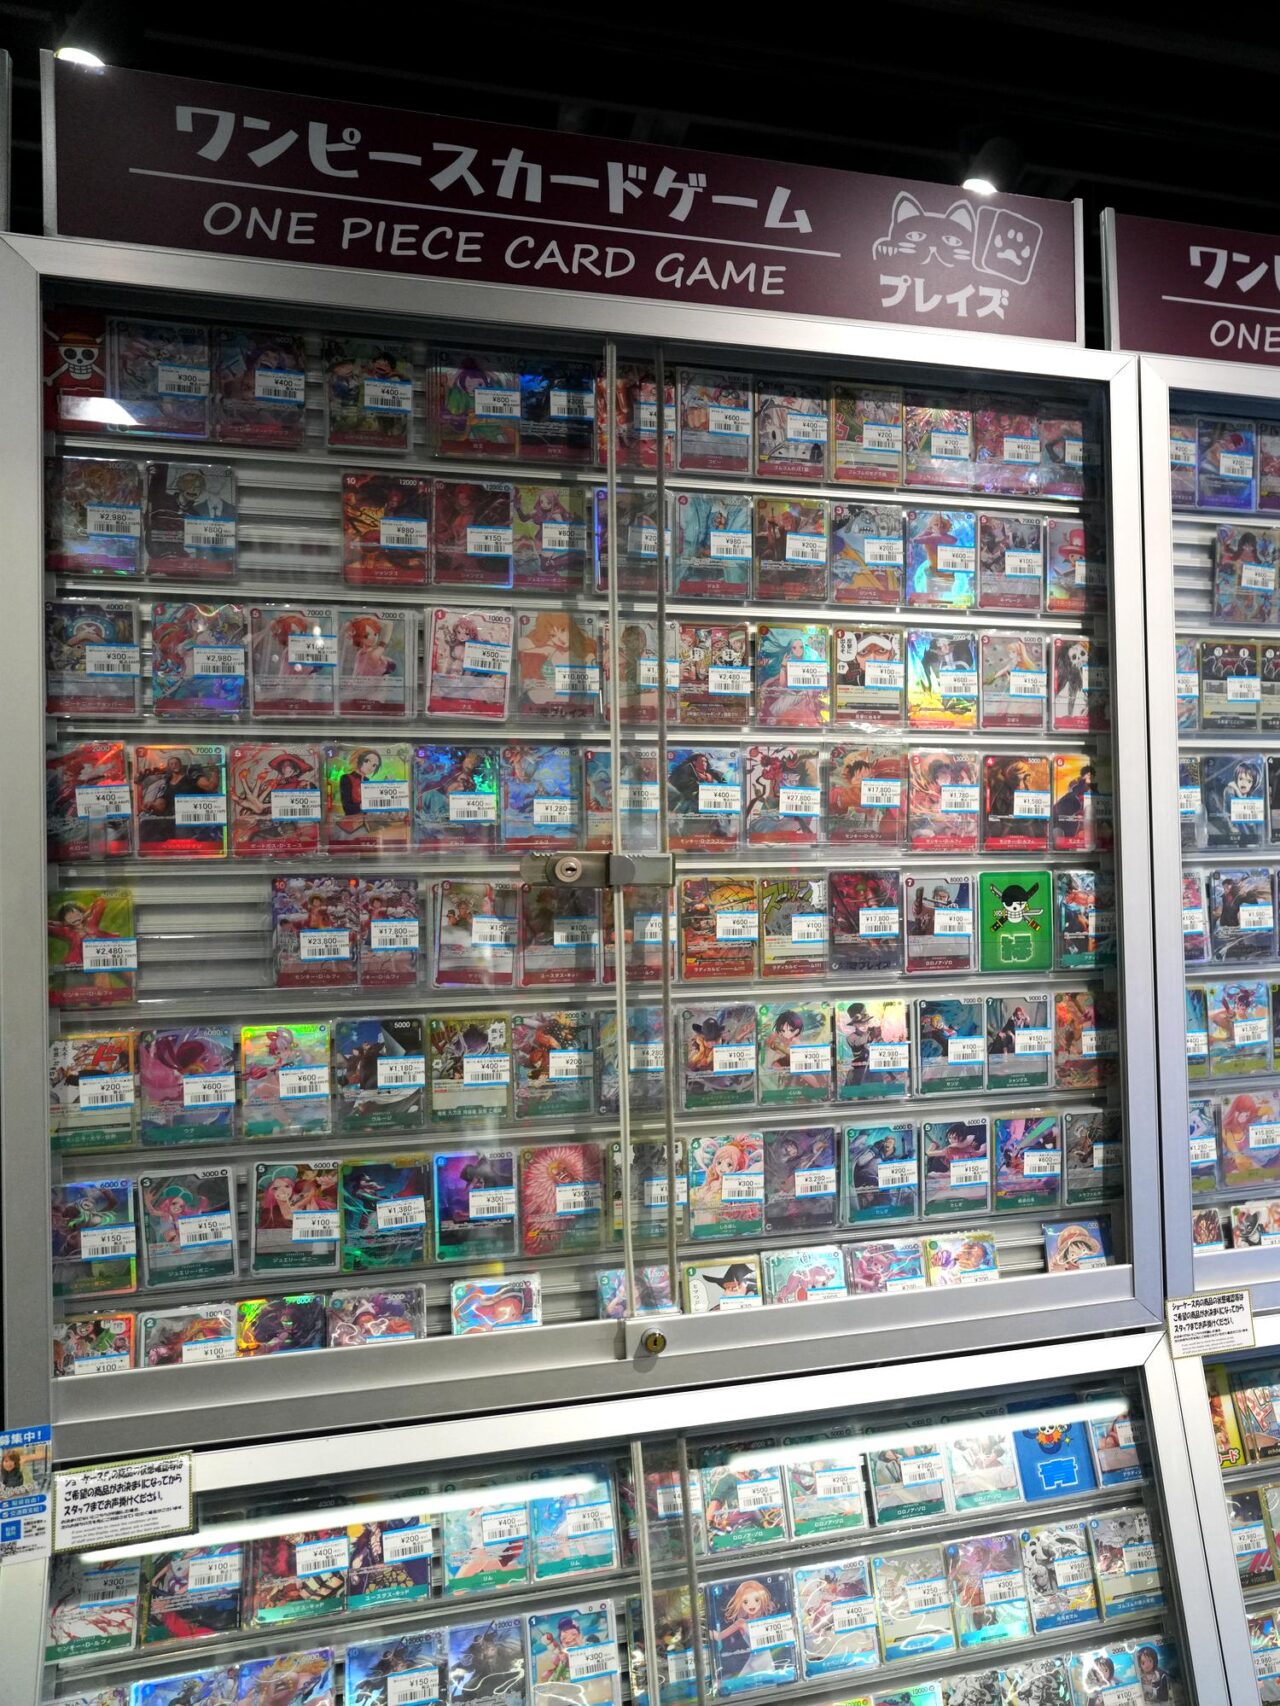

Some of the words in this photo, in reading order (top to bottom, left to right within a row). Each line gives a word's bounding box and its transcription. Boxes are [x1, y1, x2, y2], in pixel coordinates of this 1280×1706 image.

[176, 105, 813, 234] ワンピースカードゲーム
[202, 201, 317, 245] ONE
[341, 217, 484, 264] PIECE
[503, 236, 635, 280] CARD
[655, 253, 786, 296] GAME
[879, 274, 1010, 320] プレイズ
[178, 374, 197, 382] ¥300
[274, 379, 293, 387] ¥400
[381, 388, 399, 396] ¥400
[100, 513, 127, 522] ¥2,980
[397, 526, 414, 534] ¥980
[485, 534, 501, 542] ¥150
[107, 653, 127, 661] ¥300
[206, 654, 232, 662] ¥2,980
[482, 650, 499, 658] ¥500
[96, 793, 116, 801] ¥400
[290, 797, 309, 805] ¥500
[193, 802, 212, 810] ¥100
[379, 927, 408, 935] ¥17,800
[307, 937, 337, 945] ¥23,800
[96, 947, 123, 955] ¥2,480
[389, 1064, 413, 1072] ¥1,180
[297, 1074, 317, 1082] ¥600
[100, 1083, 121, 1091] ¥200
[202, 1082, 222, 1090] ¥600
[486, 1195, 504, 1203] ¥300
[388, 1205, 413, 1213] ¥1,380
[198, 1221, 218, 1229] ¥150
[101, 1234, 122, 1242] ¥150
[96, 1363, 117, 1372] ¥100
[752, 1487, 769, 1495] ¥500
[582, 1511, 600, 1519] ¥100
[498, 1517, 516, 1526] ¥400
[401, 1534, 420, 1543] ¥200
[313, 1547, 333, 1556] ¥400
[208, 1562, 228, 1570] ¥100
[103, 1577, 124, 1586] ¥300
[765, 1624, 782, 1632] ¥700
[585, 1652, 603, 1661] ¥300
[409, 1677, 429, 1687] ¥150
